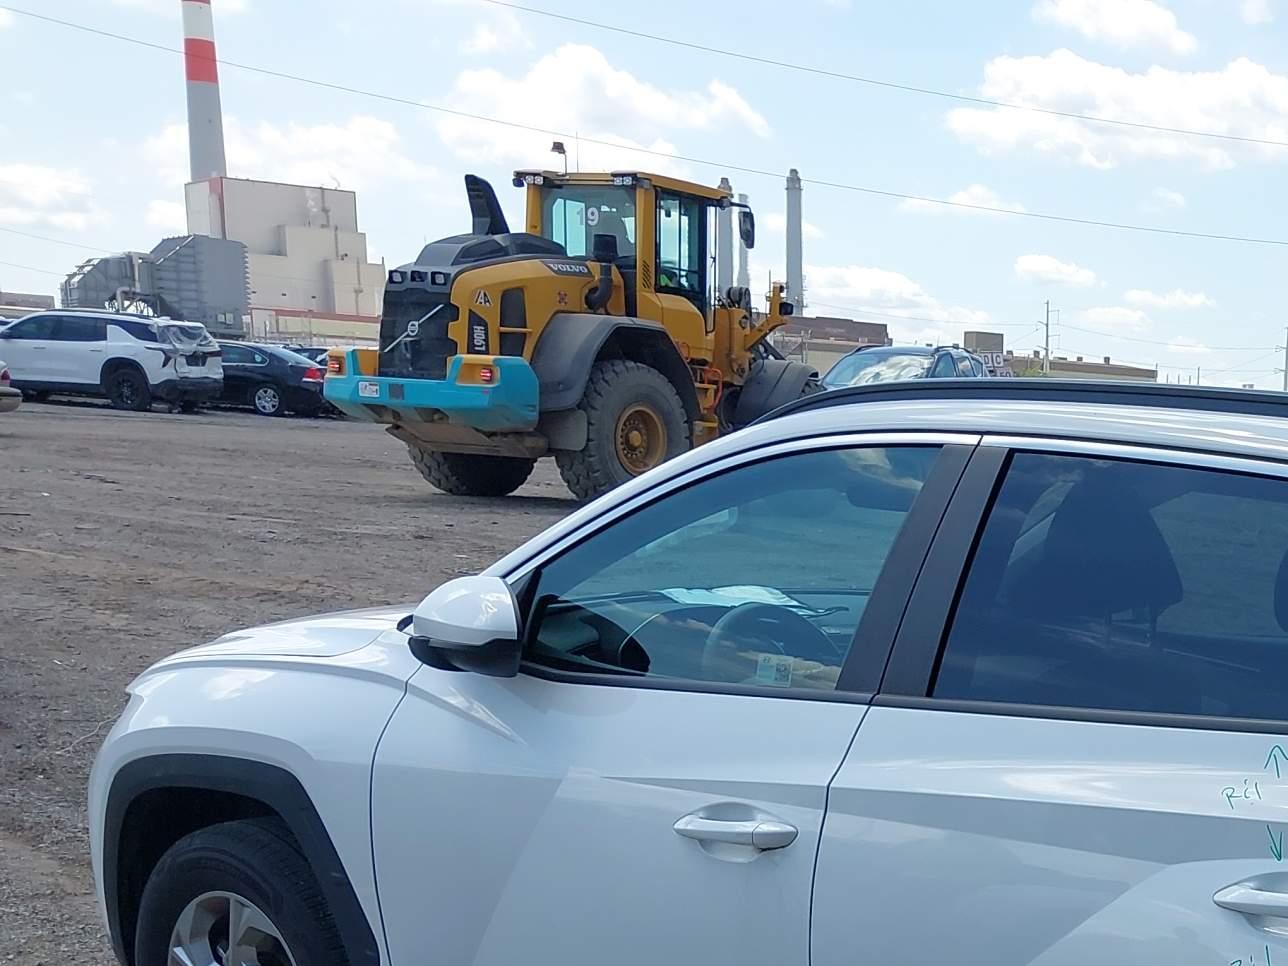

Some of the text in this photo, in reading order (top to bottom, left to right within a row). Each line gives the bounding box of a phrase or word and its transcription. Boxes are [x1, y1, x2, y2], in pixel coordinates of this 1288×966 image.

[576, 207, 600, 226] 19
[547, 263, 589, 274] VOLVO
[473, 325, 486, 351] L90H
